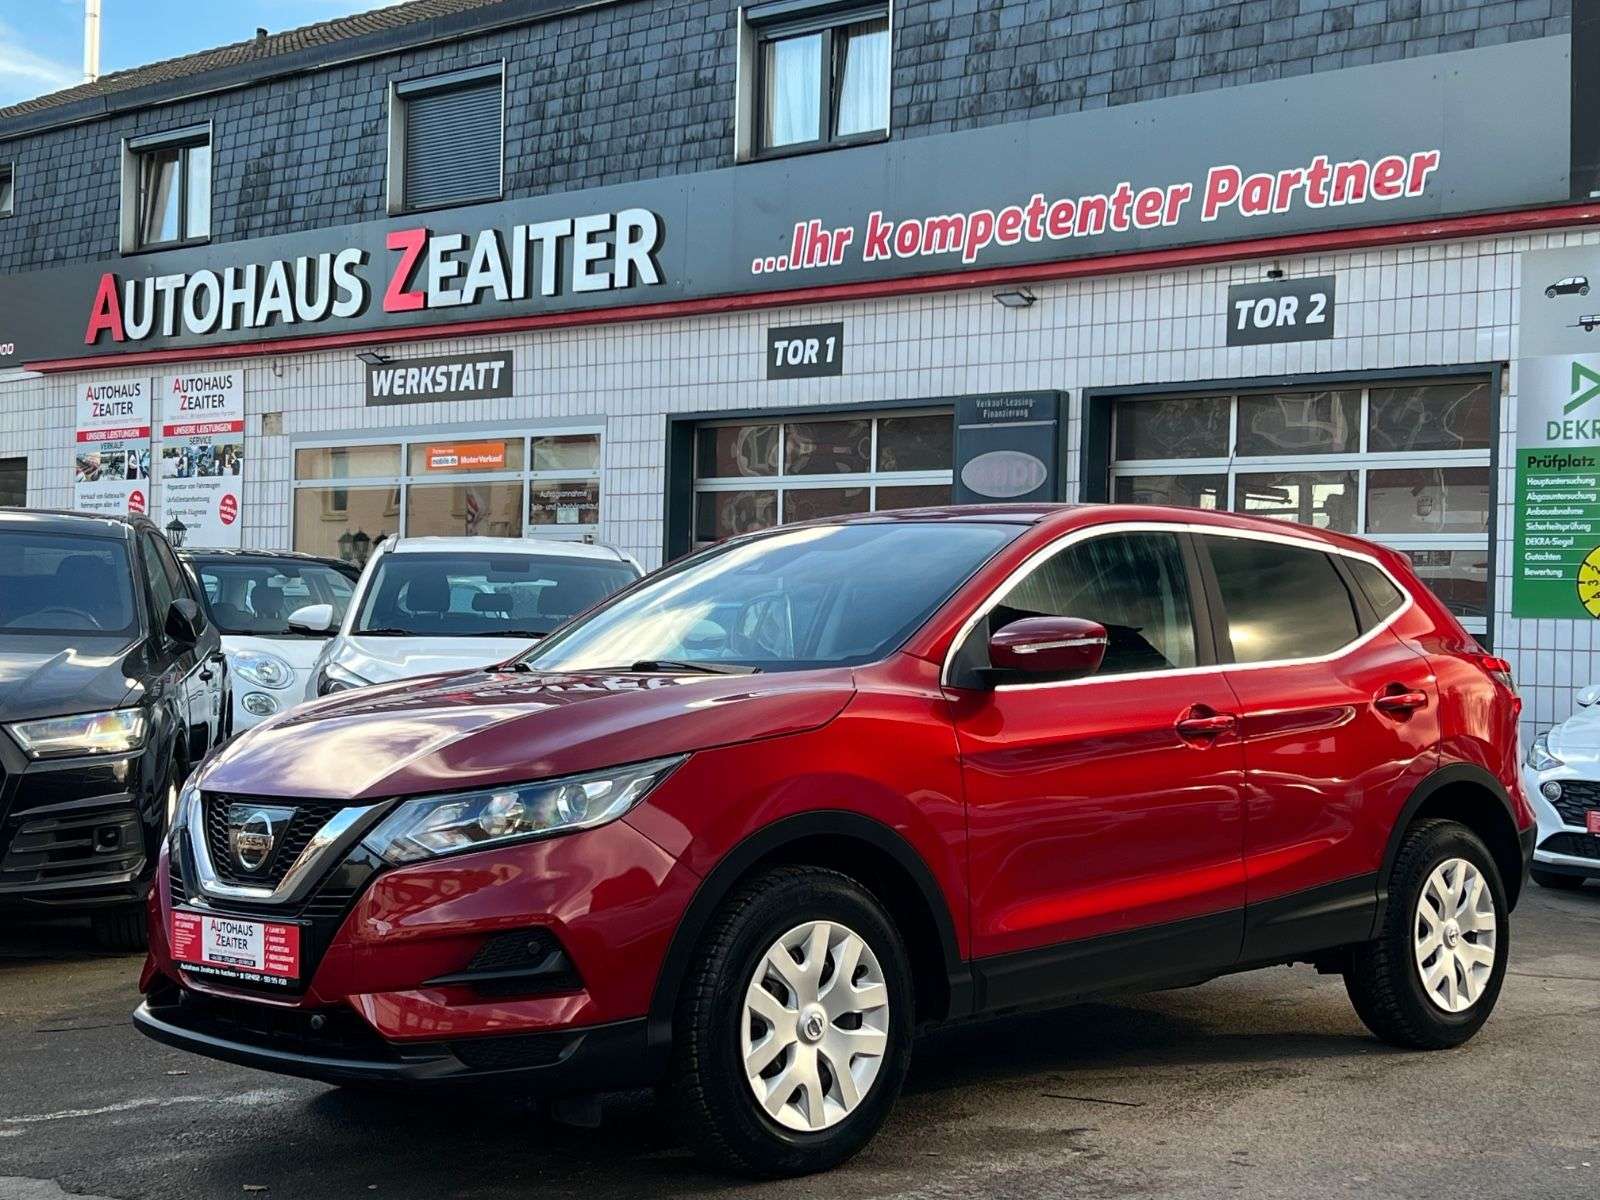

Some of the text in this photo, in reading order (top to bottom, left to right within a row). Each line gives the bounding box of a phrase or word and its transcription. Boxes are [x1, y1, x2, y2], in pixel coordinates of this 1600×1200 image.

[752, 150, 1440, 274] ...Ihr kompetenter Partner
[84, 208, 661, 344] AUTOHAUS ZEAITER
[1235, 293, 1327, 330] TOR 2
[0, 343, 14, 355] 00
[774, 336, 836, 366] TOR 1
[173, 375, 233, 393] AUTOHAUS
[372, 361, 505, 397] WERKSTATT
[86, 383, 141, 401] AUTOHAUS
[180, 394, 225, 411] ZEAITER
[92, 402, 133, 417] ZEAITER
[983, 408, 1029, 419] Finanzierung
[86, 428, 140, 441] UNSERE LEISTUNGEN
[173, 422, 232, 435] UNSERE LEISTUNGEN
[100, 441, 124, 450] VERKAUF
[189, 436, 212, 446] SERVICE
[1527, 454, 1596, 471] Prüfplatz
[1527, 475, 1597, 487] Hauptuntersuchung
[1526, 491, 1597, 502] Abgasuntersuchung
[1526, 506, 1584, 516] Anbauabnahme
[1525, 520, 1592, 532] Sicherheitsprüfung
[1525, 536, 1574, 547] DEKRA-Siegel
[1525, 551, 1562, 561] Gutachten
[1524, 567, 1564, 578] Bewertung
[239, 837, 272, 849] NISSAN
[210, 919, 254, 937] AUTOHAUS
[216, 933, 249, 950] ZEAITER
